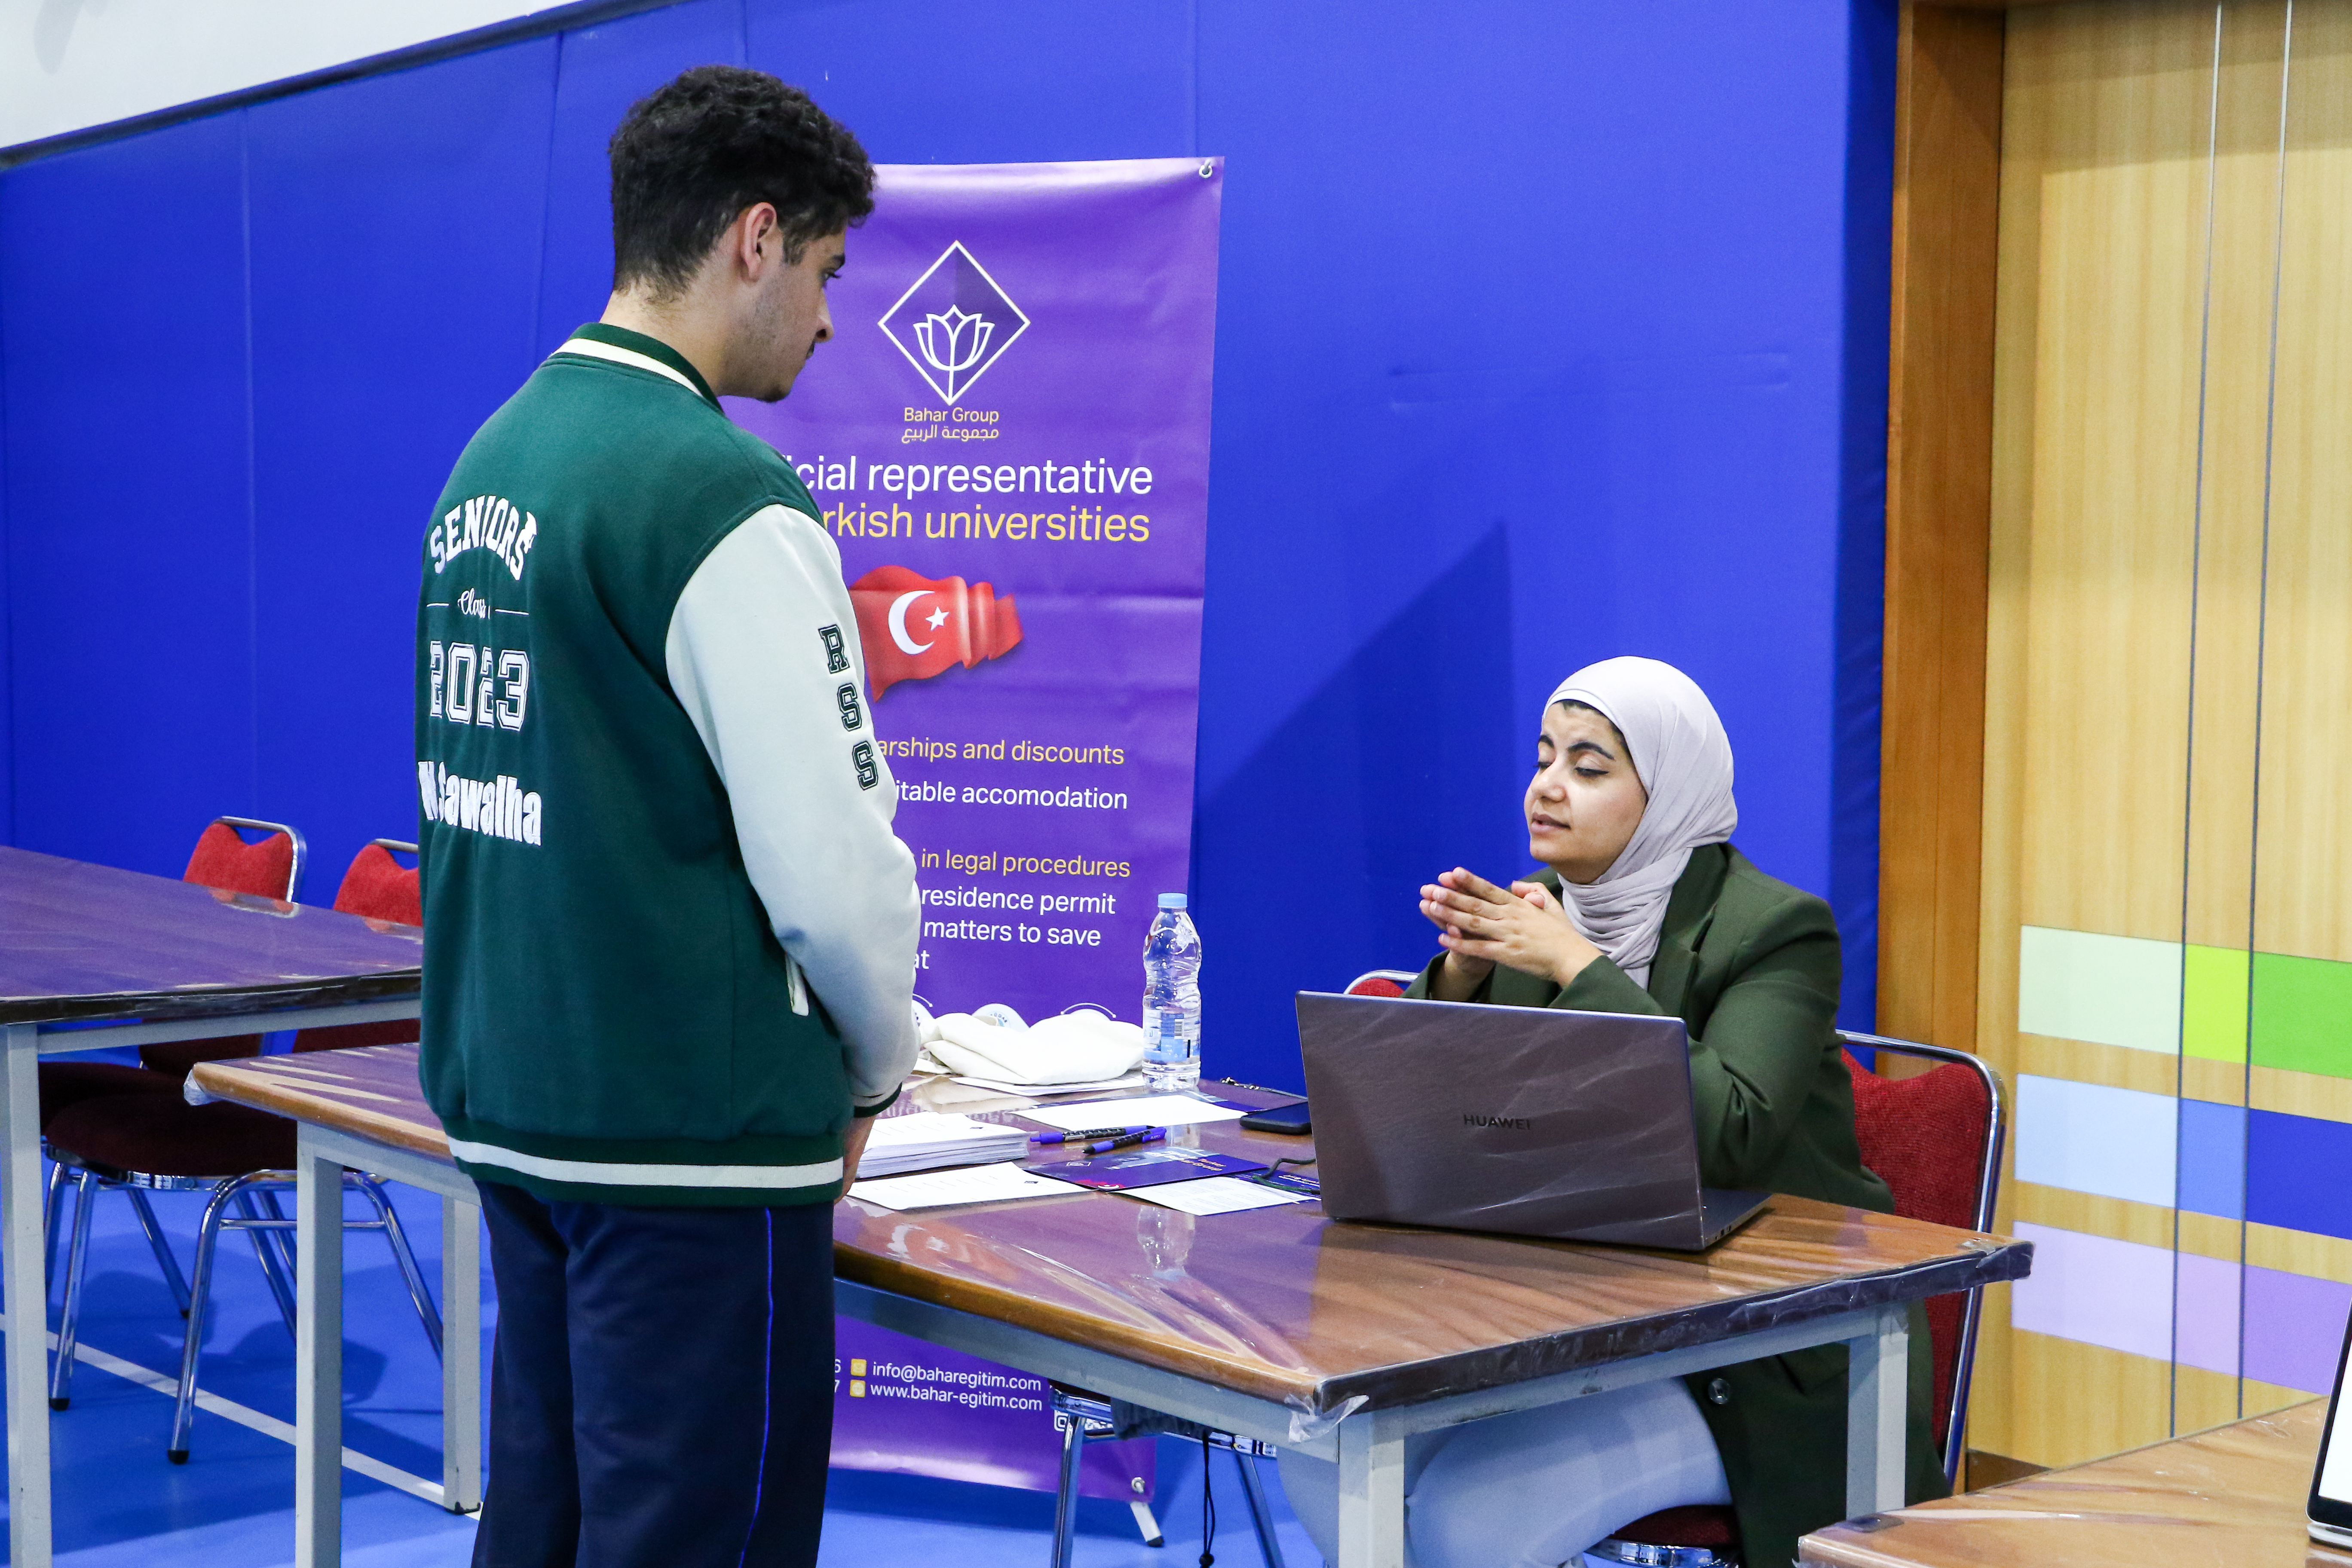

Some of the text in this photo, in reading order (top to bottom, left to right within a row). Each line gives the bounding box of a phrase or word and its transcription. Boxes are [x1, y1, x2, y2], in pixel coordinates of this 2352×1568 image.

[904, 407, 999, 425] Bahar Group
[901, 424, 999, 444] مجموعة الربيع
[791, 455, 1153, 500] cial representative
[925, 504, 1150, 542] universities
[430, 495, 531, 581] SENIORS
[430, 640, 530, 732] 2023
[963, 739, 1005, 760] and
[1011, 740, 1124, 765] discounts
[962, 786, 1127, 809] accomodation
[922, 848, 1130, 878] in legal procedures
[922, 885, 1117, 916] residence permit
[924, 919, 1101, 946] matters to save
[1463, 1114, 1531, 1130] HUAWEI
[873, 1361, 1041, 1391] info@baharegitim.com
[870, 1384, 1042, 1411] www.bahar-egitim.com
